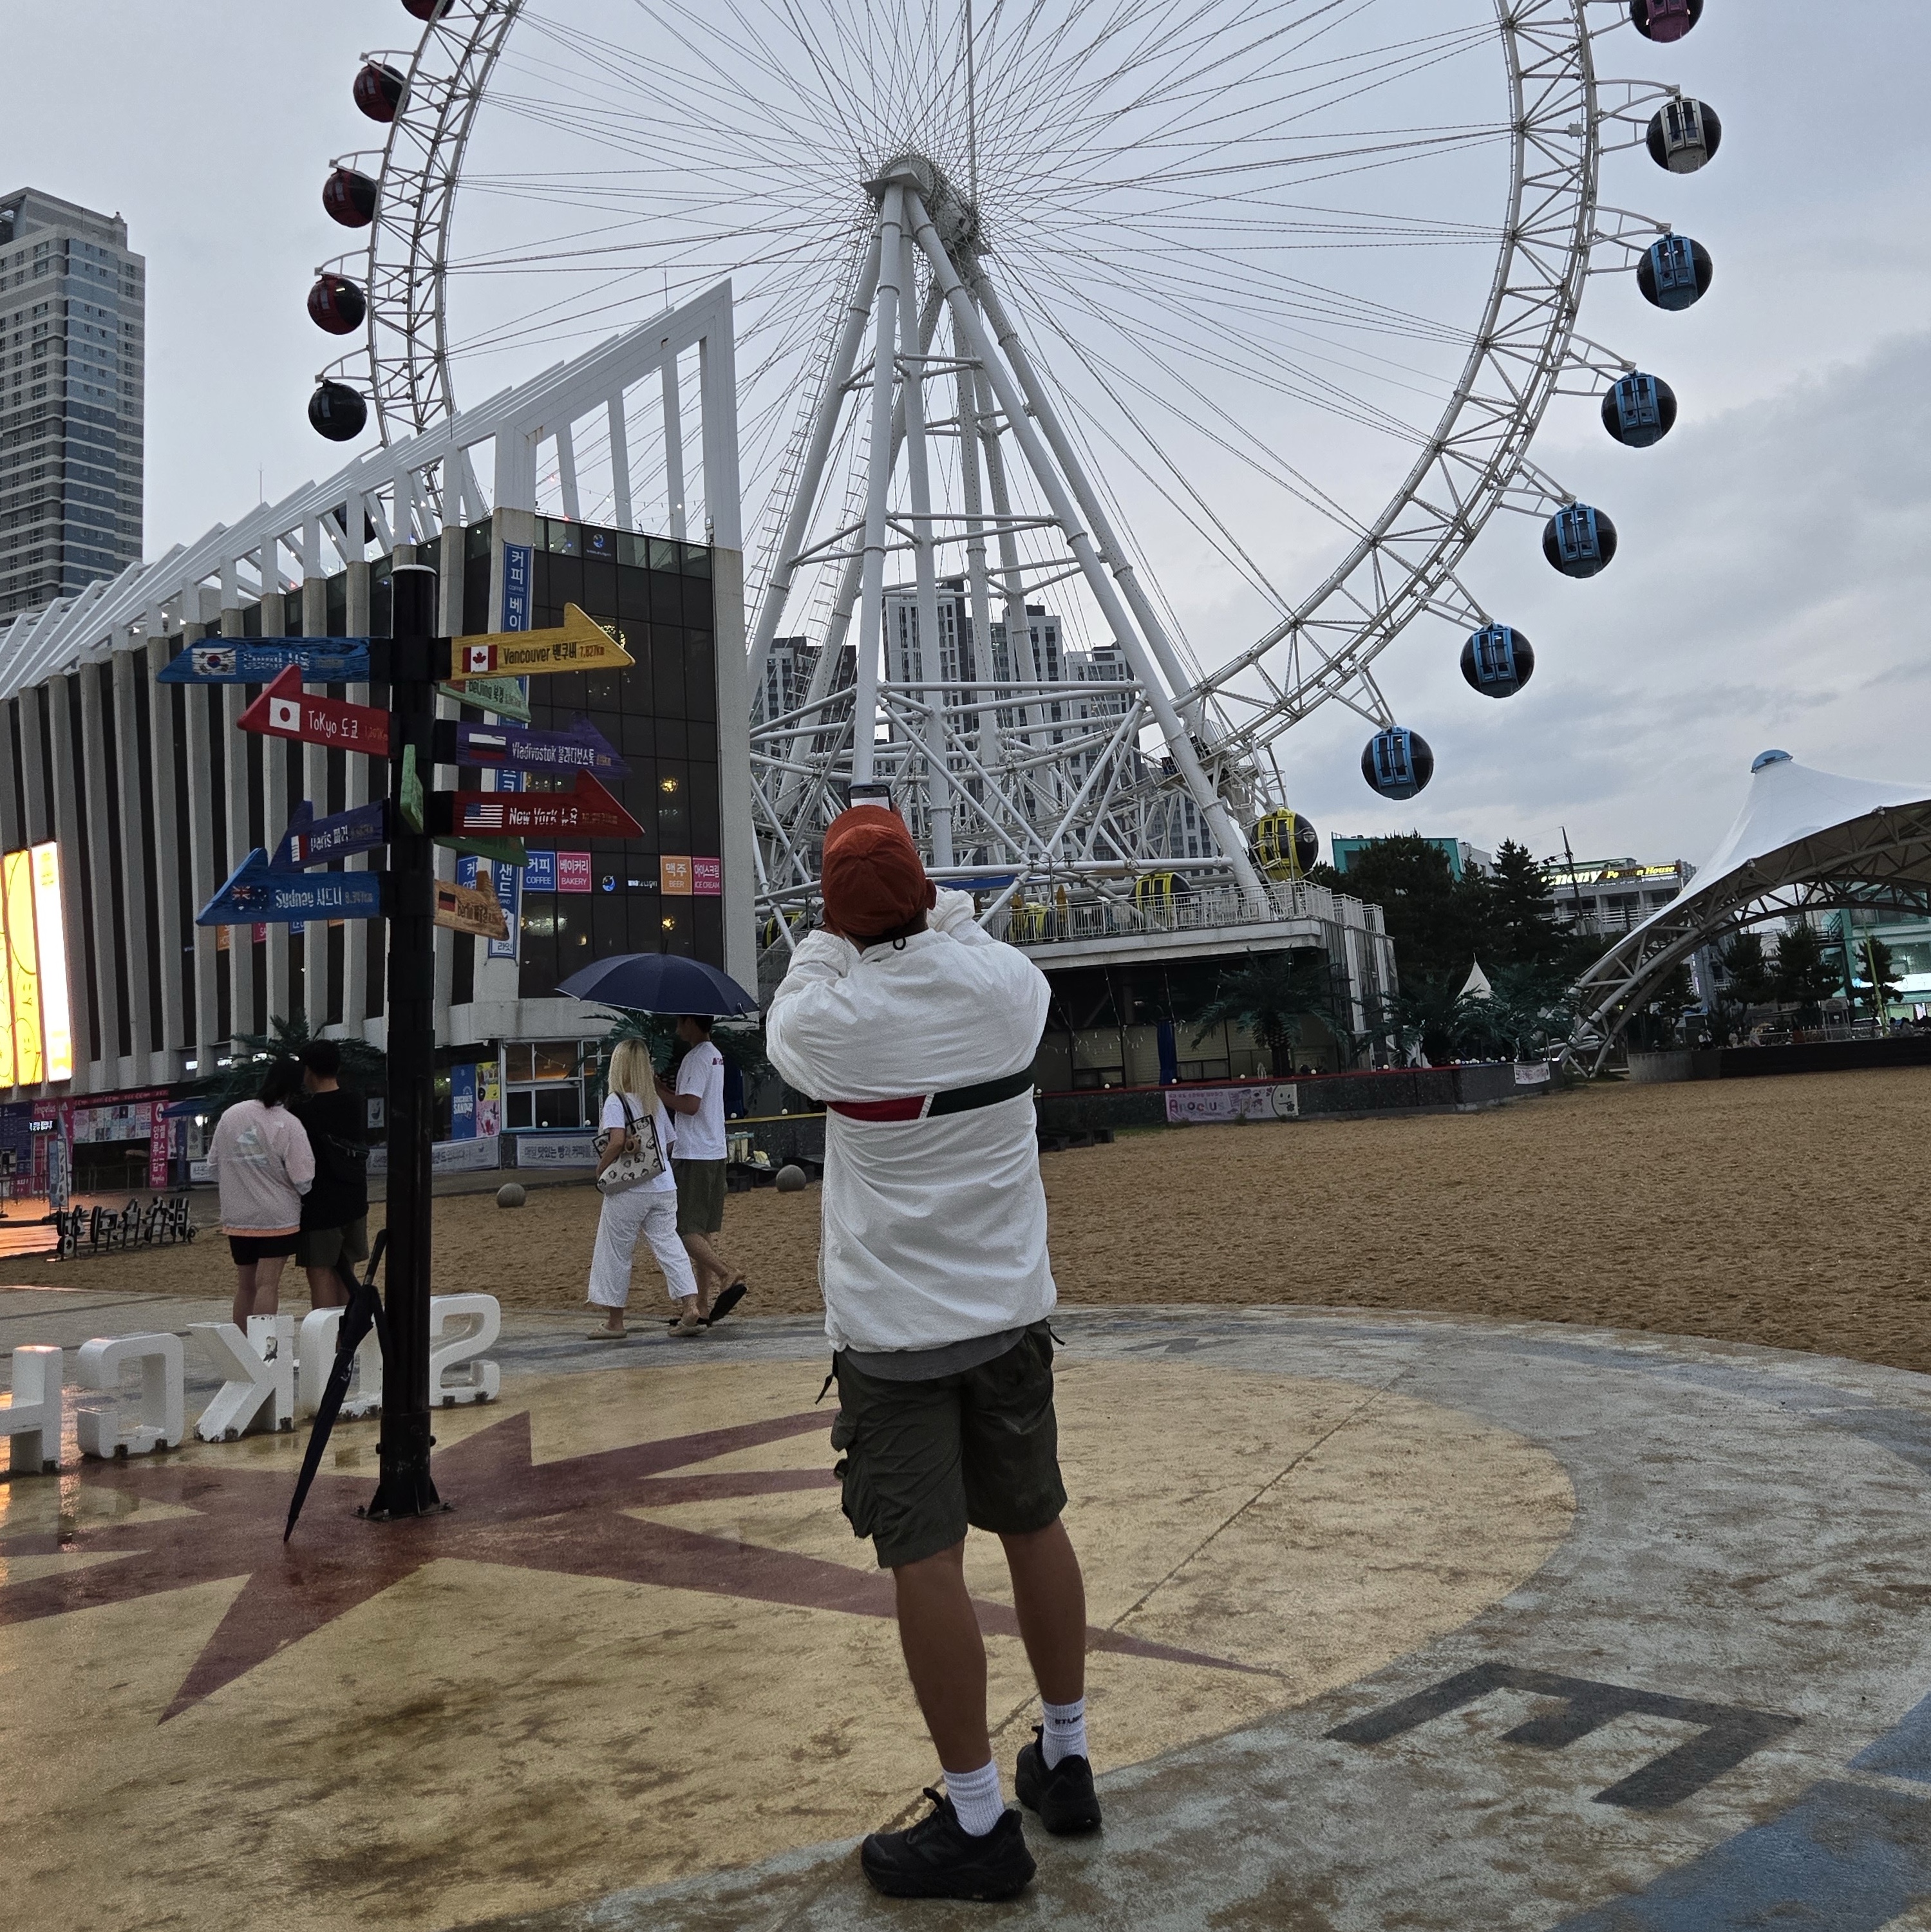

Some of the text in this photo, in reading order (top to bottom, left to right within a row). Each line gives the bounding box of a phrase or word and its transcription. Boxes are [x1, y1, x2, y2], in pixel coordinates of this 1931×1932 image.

[511, 550, 524, 585] 커피
[504, 648, 550, 665] Vancouver
[341, 718, 358, 739] 도쿄
[513, 742, 556, 762] Vladivostok
[558, 746, 595, 766] 블라디보스톡
[509, 807, 531, 825] New
[534, 807, 558, 825] York
[561, 807, 578, 826] 뉴욕
[333, 825, 348, 844] 파리
[527, 858, 551, 874] 커피
[560, 859, 589, 874] 베이커리
[665, 863, 687, 877] 맥주
[694, 863, 720, 878] 아이스크림
[1606, 870, 1644, 879] Pension
[1644, 866, 1675, 875] House
[498, 863, 512, 897] 샌드
[526, 876, 552, 885] COFFEE
[668, 880, 685, 888] BEER
[275, 889, 314, 908] Sydney
[317, 886, 342, 906] 시드니
